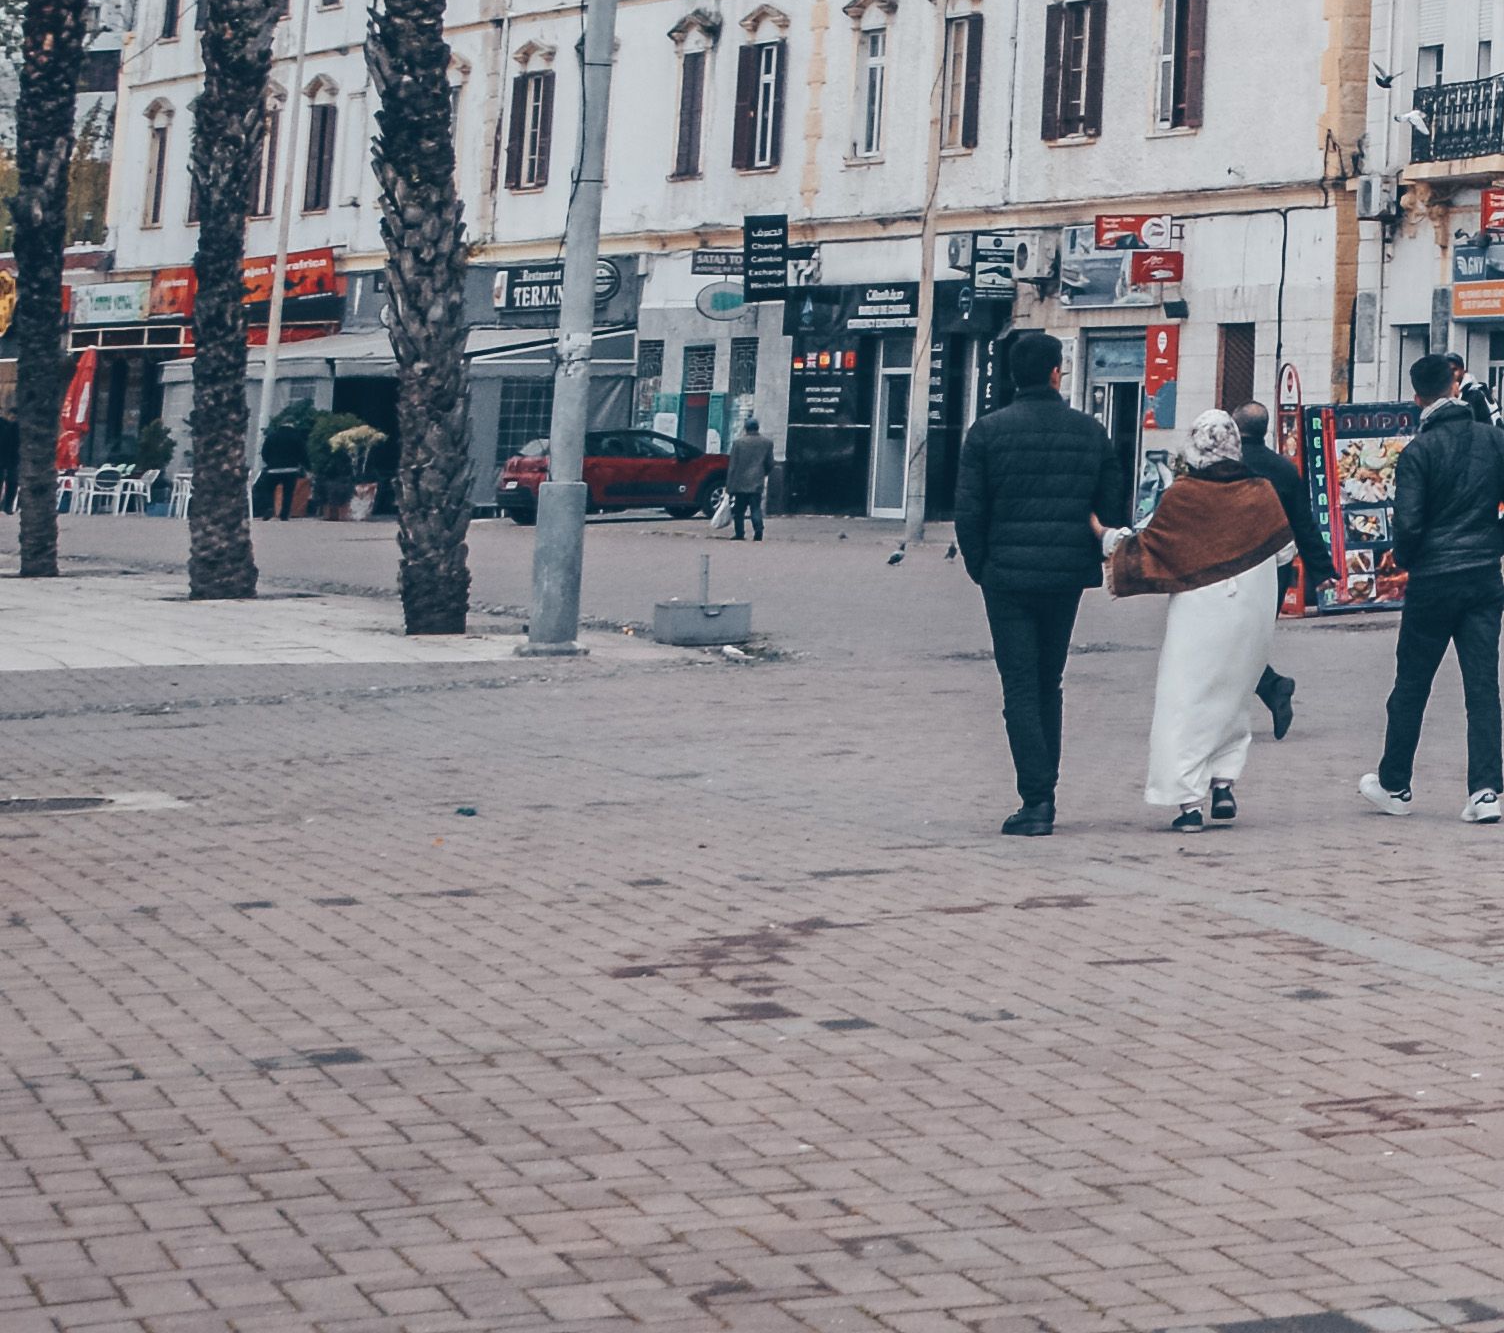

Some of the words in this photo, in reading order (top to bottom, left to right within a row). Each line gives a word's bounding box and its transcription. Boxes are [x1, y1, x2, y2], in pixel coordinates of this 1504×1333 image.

[751, 243, 783, 251] Change
[696, 255, 726, 265] SATAS
[514, 285, 564, 307] TERMIN
